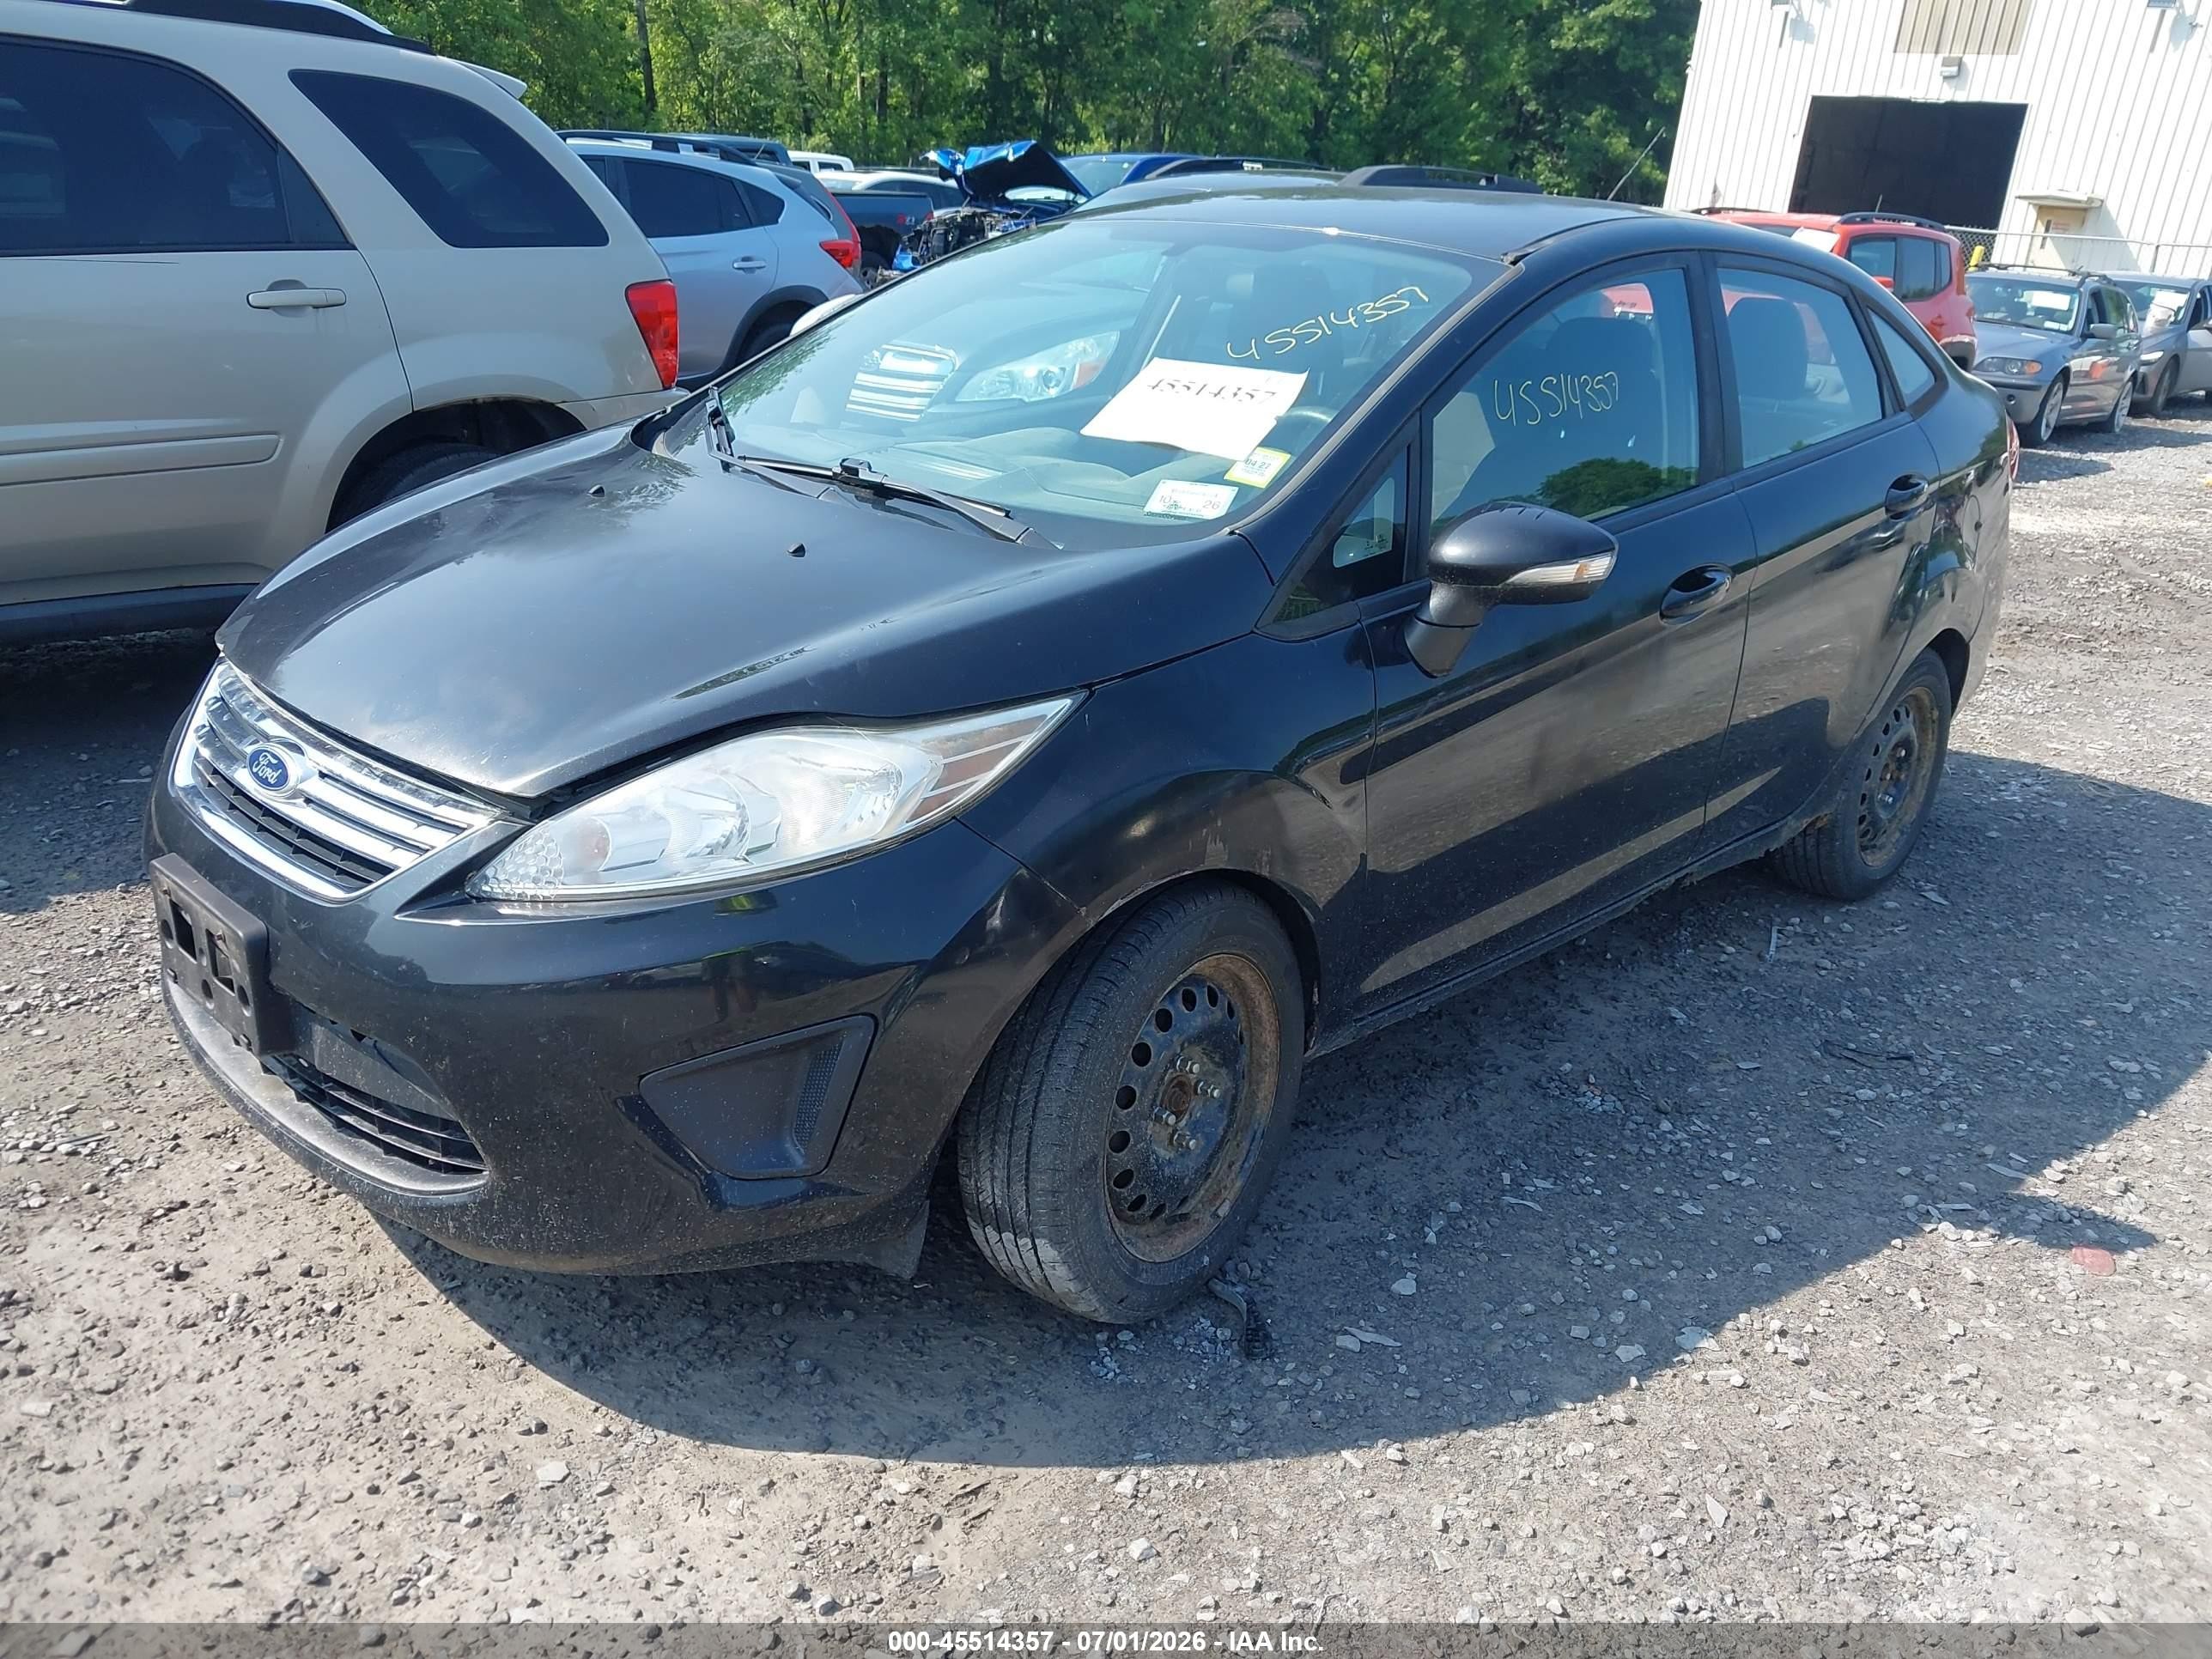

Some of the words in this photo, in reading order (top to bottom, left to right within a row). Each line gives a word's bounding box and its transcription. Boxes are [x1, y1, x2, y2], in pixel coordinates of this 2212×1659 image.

[1226, 285, 1430, 360] 45514357
[1495, 371, 1619, 426] 45514357
[252, 752, 283, 784] Ford
